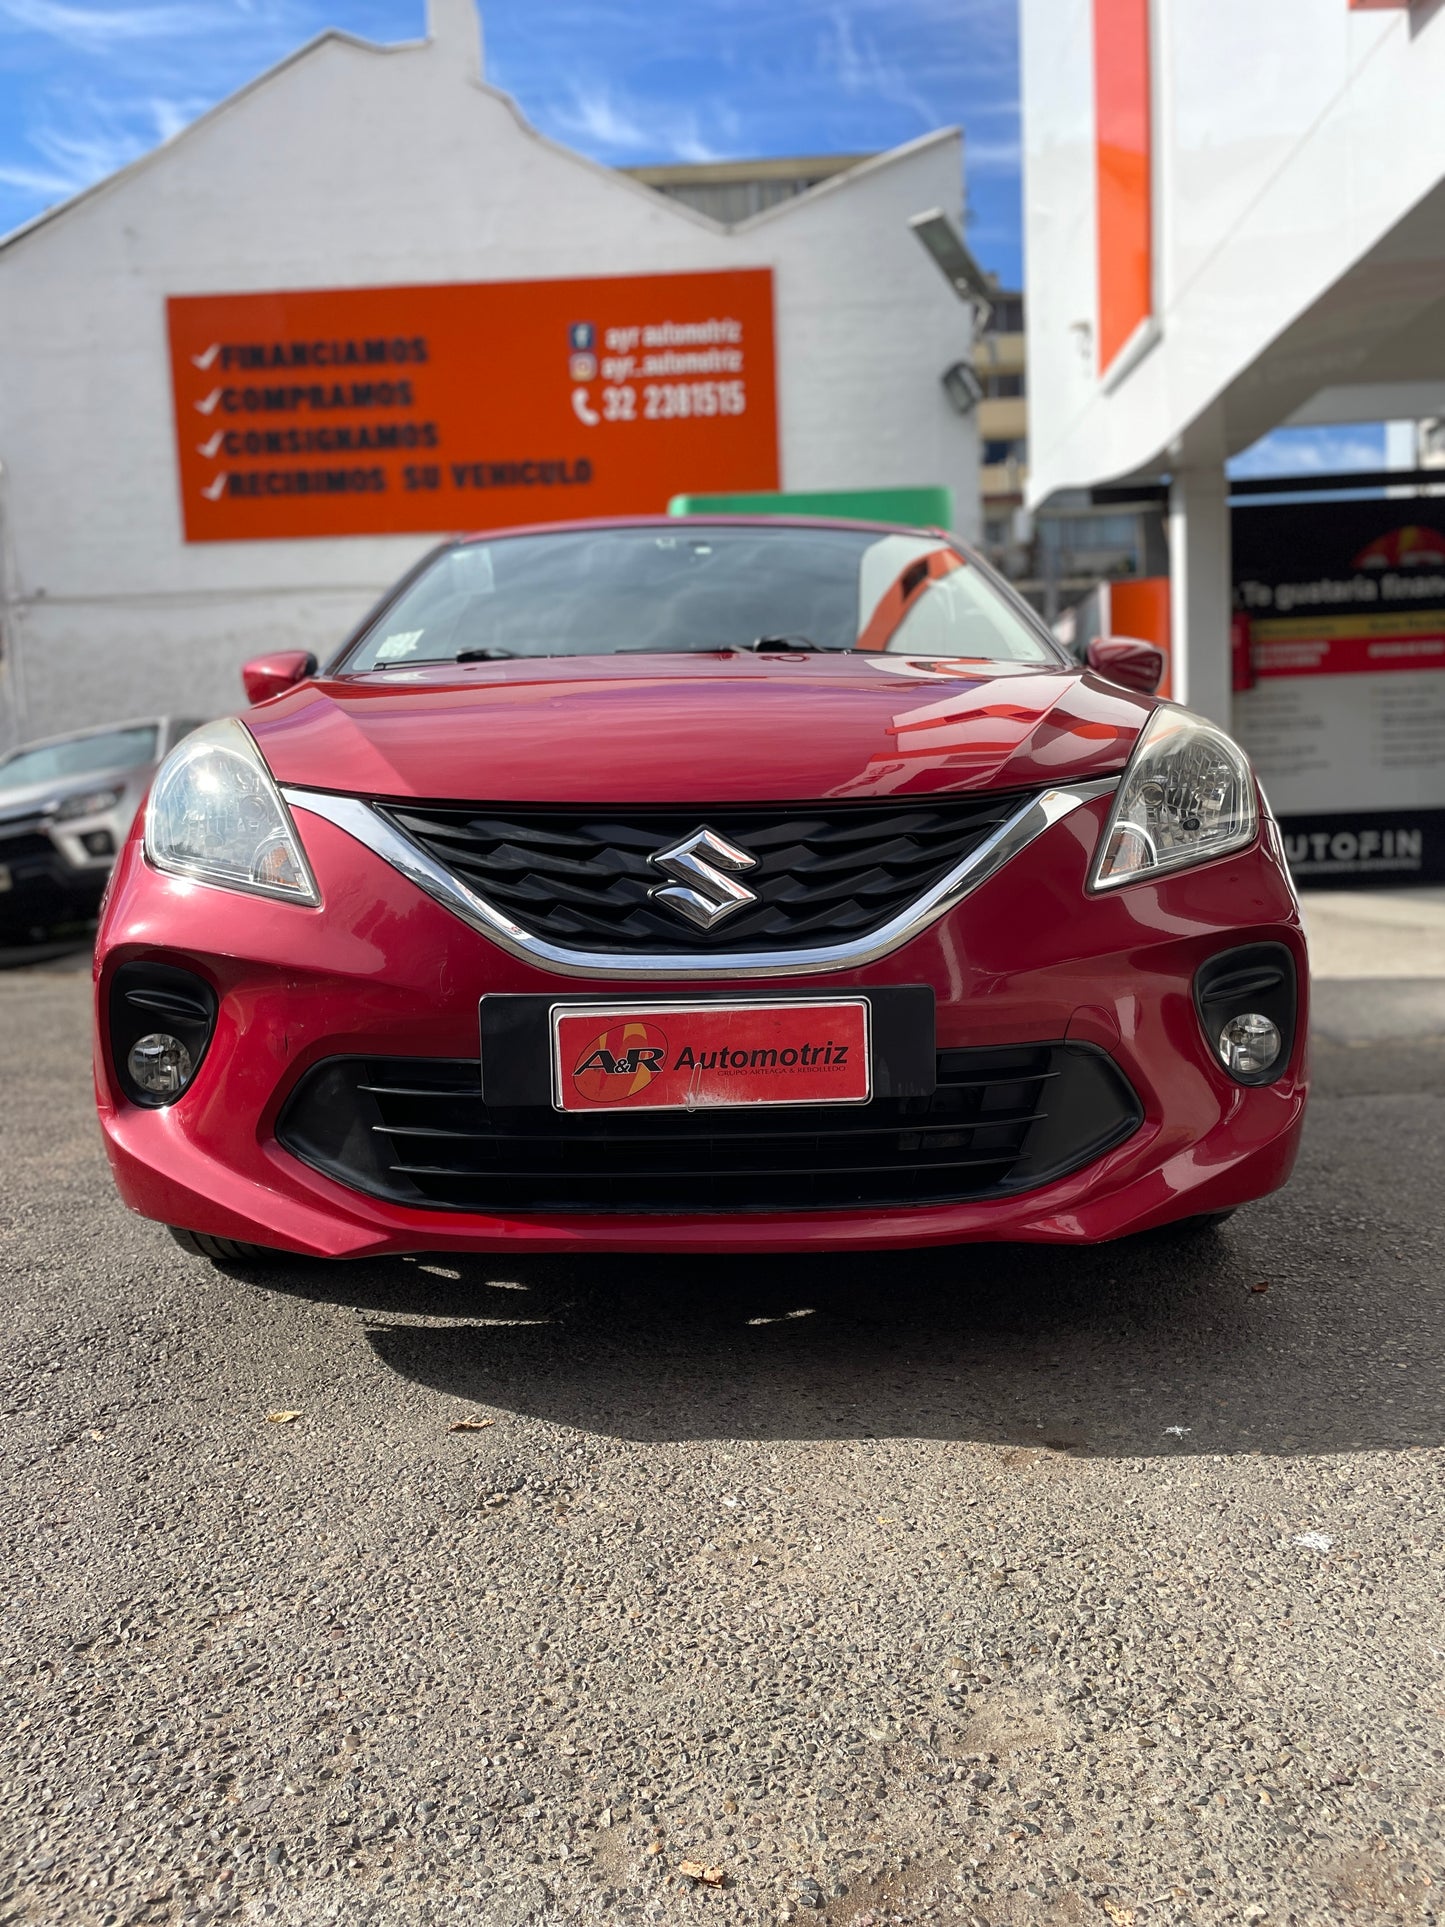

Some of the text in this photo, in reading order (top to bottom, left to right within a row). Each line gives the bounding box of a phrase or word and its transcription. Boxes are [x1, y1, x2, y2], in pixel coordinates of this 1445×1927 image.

[605, 317, 742, 354] ayr automotriz
[221, 337, 428, 370] FINANCIAMOS
[222, 381, 413, 413] COMPRAMOS
[602, 386, 637, 421] 32
[225, 423, 437, 455] CONSIGNAMOS
[229, 456, 594, 497] RECIBIMOS SU VEHICULO
[1284, 829, 1422, 862] UTOFIN
[674, 1041, 848, 1071] Automotriz
[717, 1069, 748, 1077] GRUPO
[798, 1066, 847, 1074] REBOLLEDO
